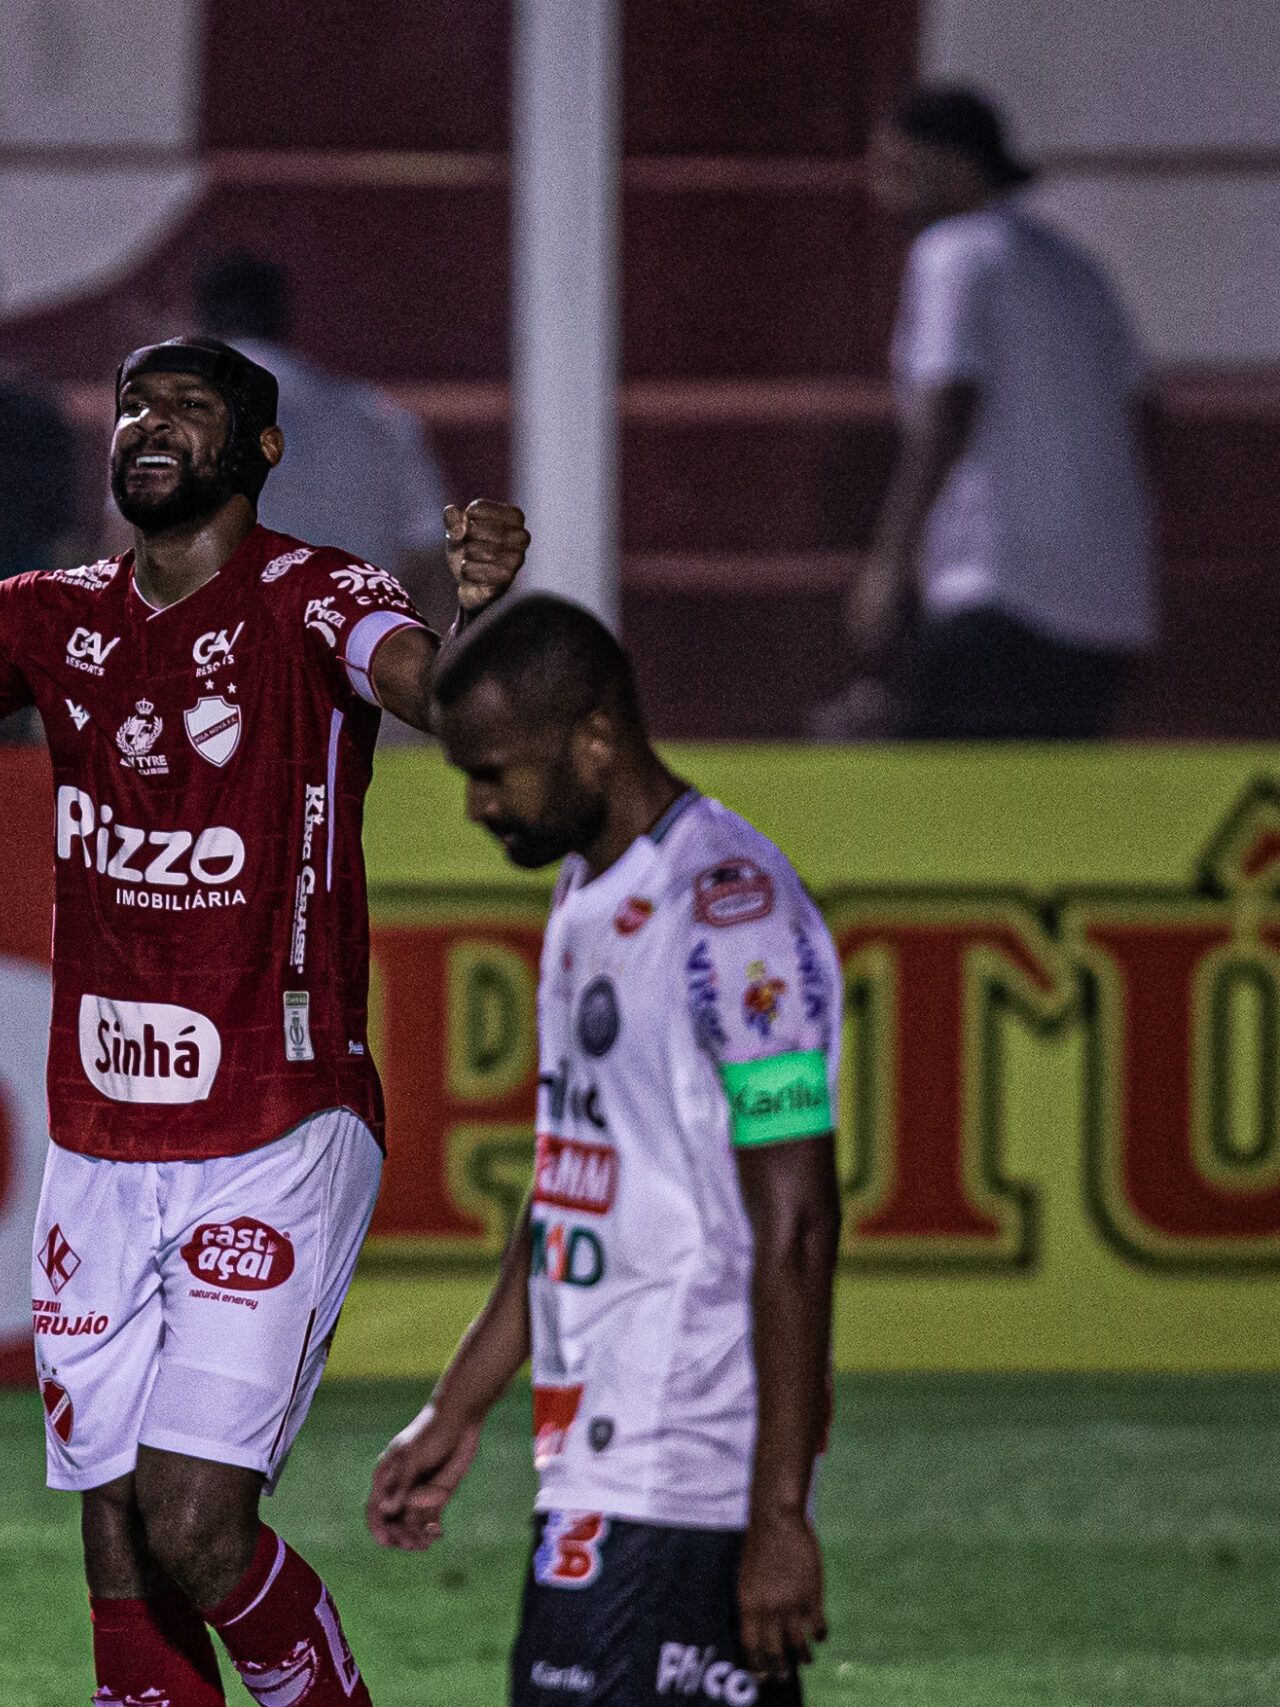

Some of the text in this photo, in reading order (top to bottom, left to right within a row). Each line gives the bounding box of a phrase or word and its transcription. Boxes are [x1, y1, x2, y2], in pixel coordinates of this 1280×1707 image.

[66, 626, 121, 665] GAV
[192, 620, 245, 664] GAV
[115, 888, 246, 911] IMOBILIÁRIA
[95, 1018, 200, 1078] Sinhá
[202, 1225, 268, 1251] Fast
[189, 1288, 259, 1310] natural energy
